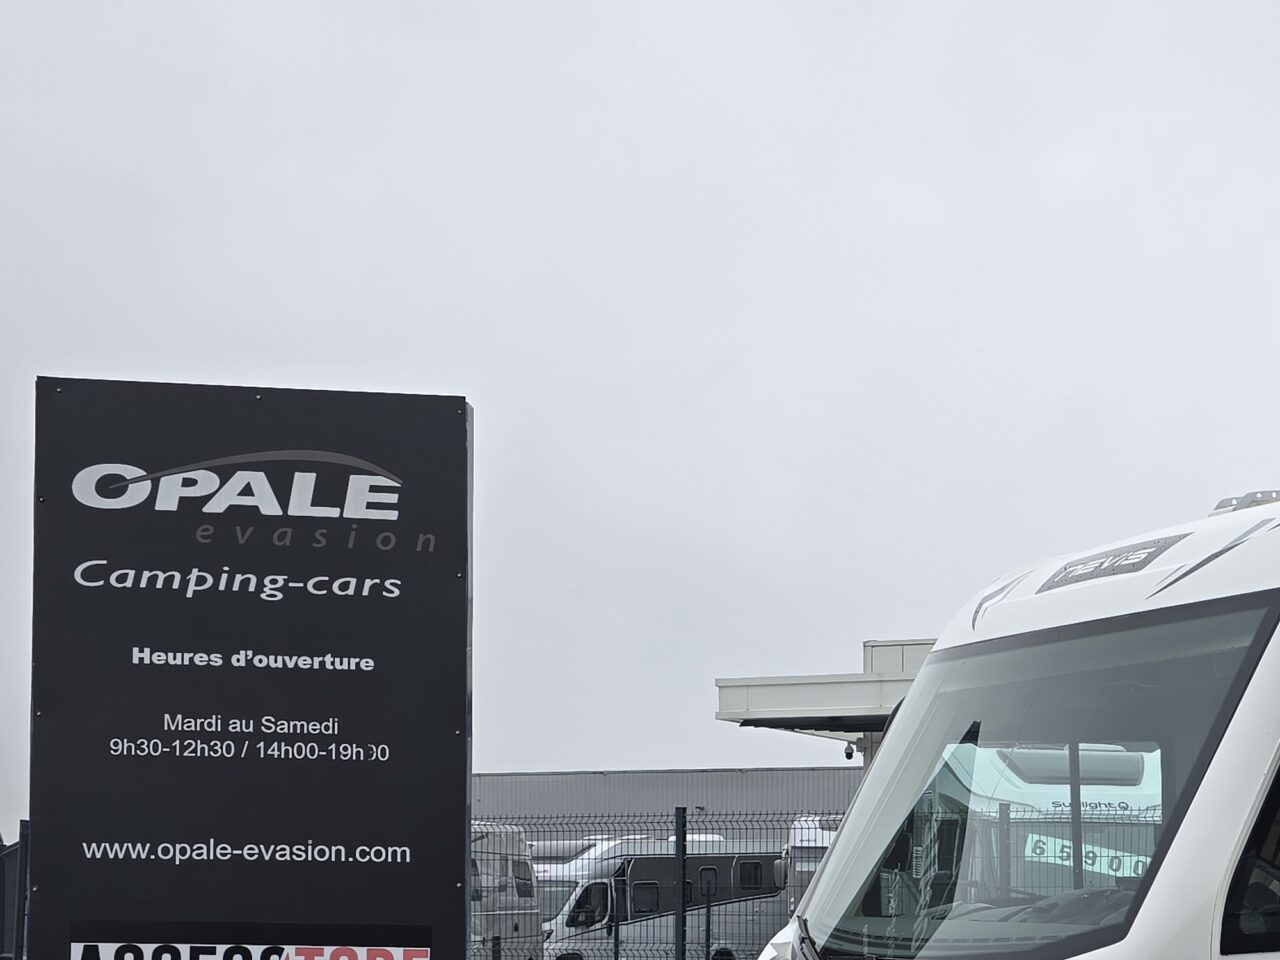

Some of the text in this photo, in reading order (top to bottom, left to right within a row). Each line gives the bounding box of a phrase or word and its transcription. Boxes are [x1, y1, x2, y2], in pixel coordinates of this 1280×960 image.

[72, 463, 402, 520] OPALE
[196, 523, 436, 553] evasion
[74, 560, 402, 601] Camping-cars
[132, 647, 375, 671] Heures d’ouverture
[164, 714, 339, 734] Mardi au Samedi
[109, 738, 235, 758] 9h30-12h30
[1051, 801, 1115, 810] Sulight
[82, 838, 411, 865] www.opale-evasion.com
